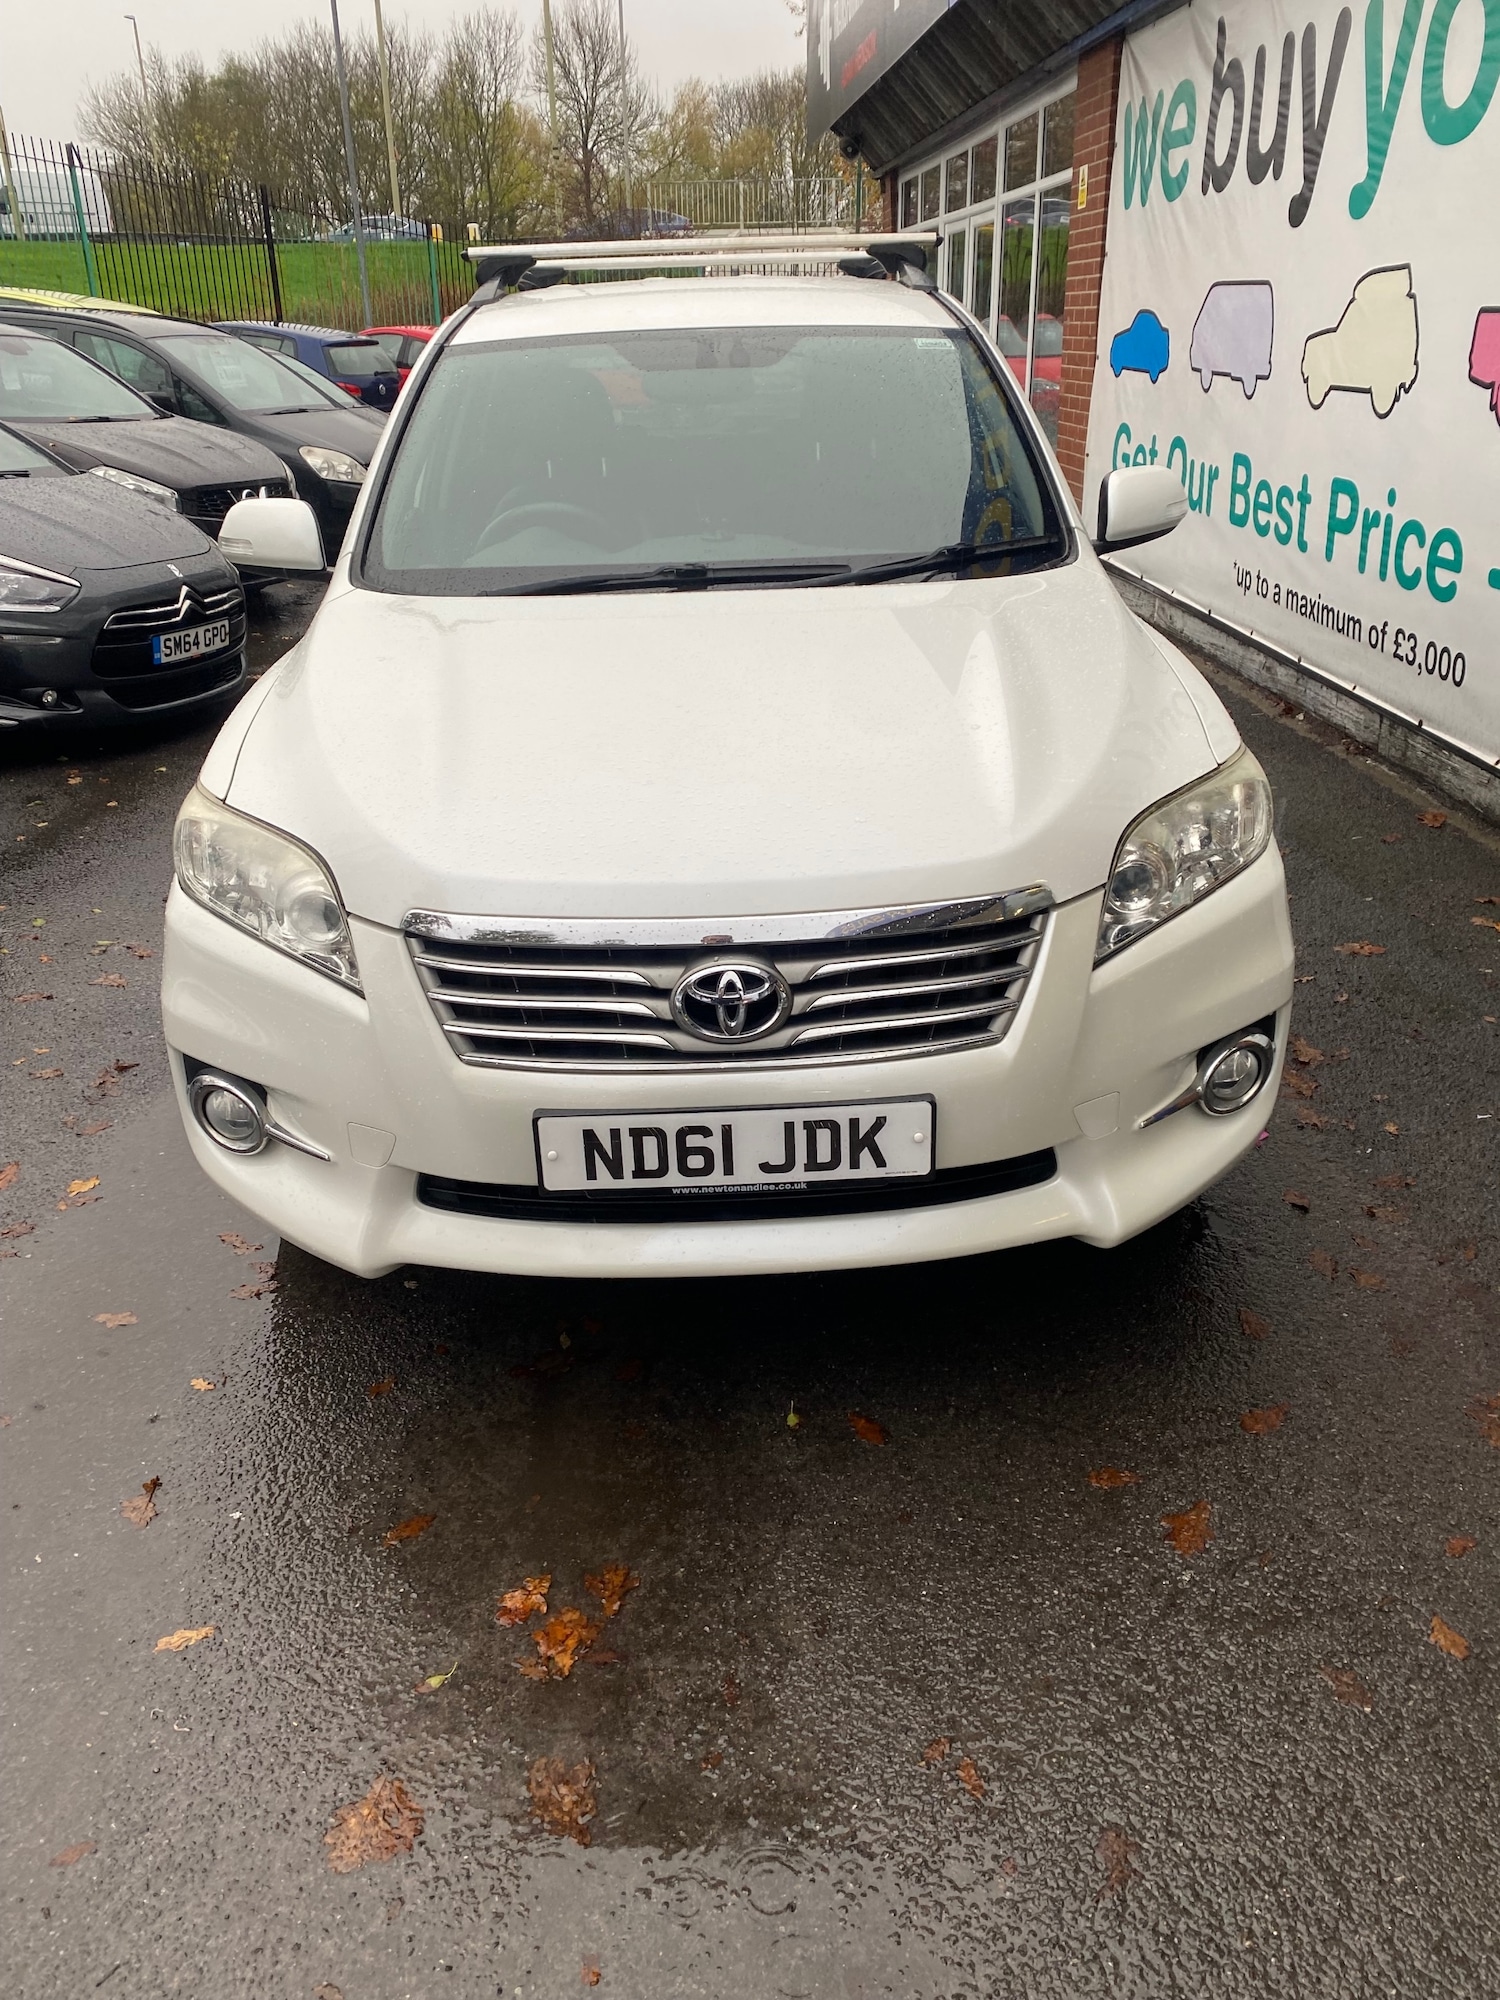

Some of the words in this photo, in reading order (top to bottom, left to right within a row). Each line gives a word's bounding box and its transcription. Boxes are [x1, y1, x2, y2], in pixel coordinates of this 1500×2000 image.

[1229, 452, 1311, 553] Best
[1325, 477, 1463, 602] Price
[163, 631, 200, 658] SM64
[203, 624, 227, 648] GPO
[1256, 569, 1269, 598] to
[1273, 583, 1281, 605] a
[1286, 587, 1362, 643] maximum
[1368, 621, 1388, 652] of
[1393, 628, 1466, 687] £3,000
[582, 1124, 734, 1181] ND61
[758, 1116, 887, 1174] JDK
[671, 1182, 808, 1194] www.newtonandlee.co.uk
